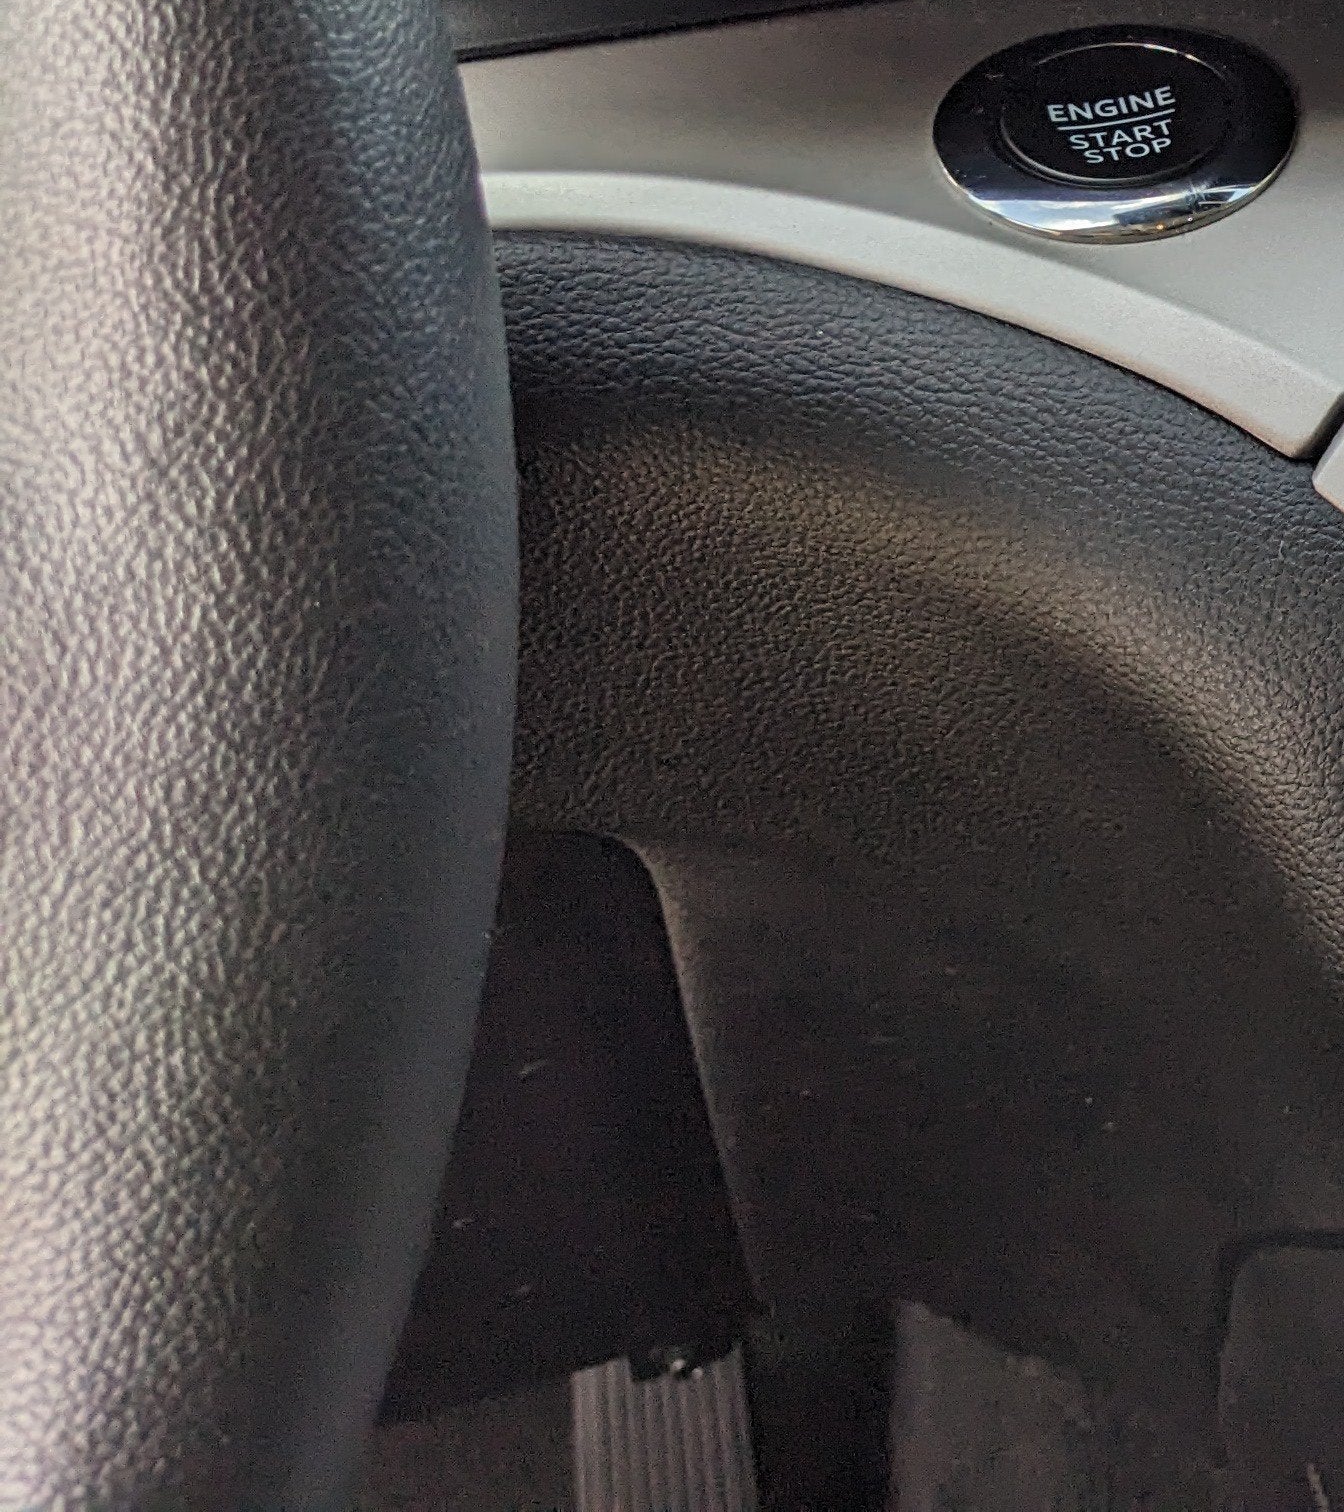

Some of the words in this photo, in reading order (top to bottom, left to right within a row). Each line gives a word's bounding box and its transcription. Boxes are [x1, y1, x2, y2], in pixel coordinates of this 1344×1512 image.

[1046, 85, 1177, 124] ENGINE
[1069, 118, 1173, 152] START
[1083, 137, 1173, 165] STOP
